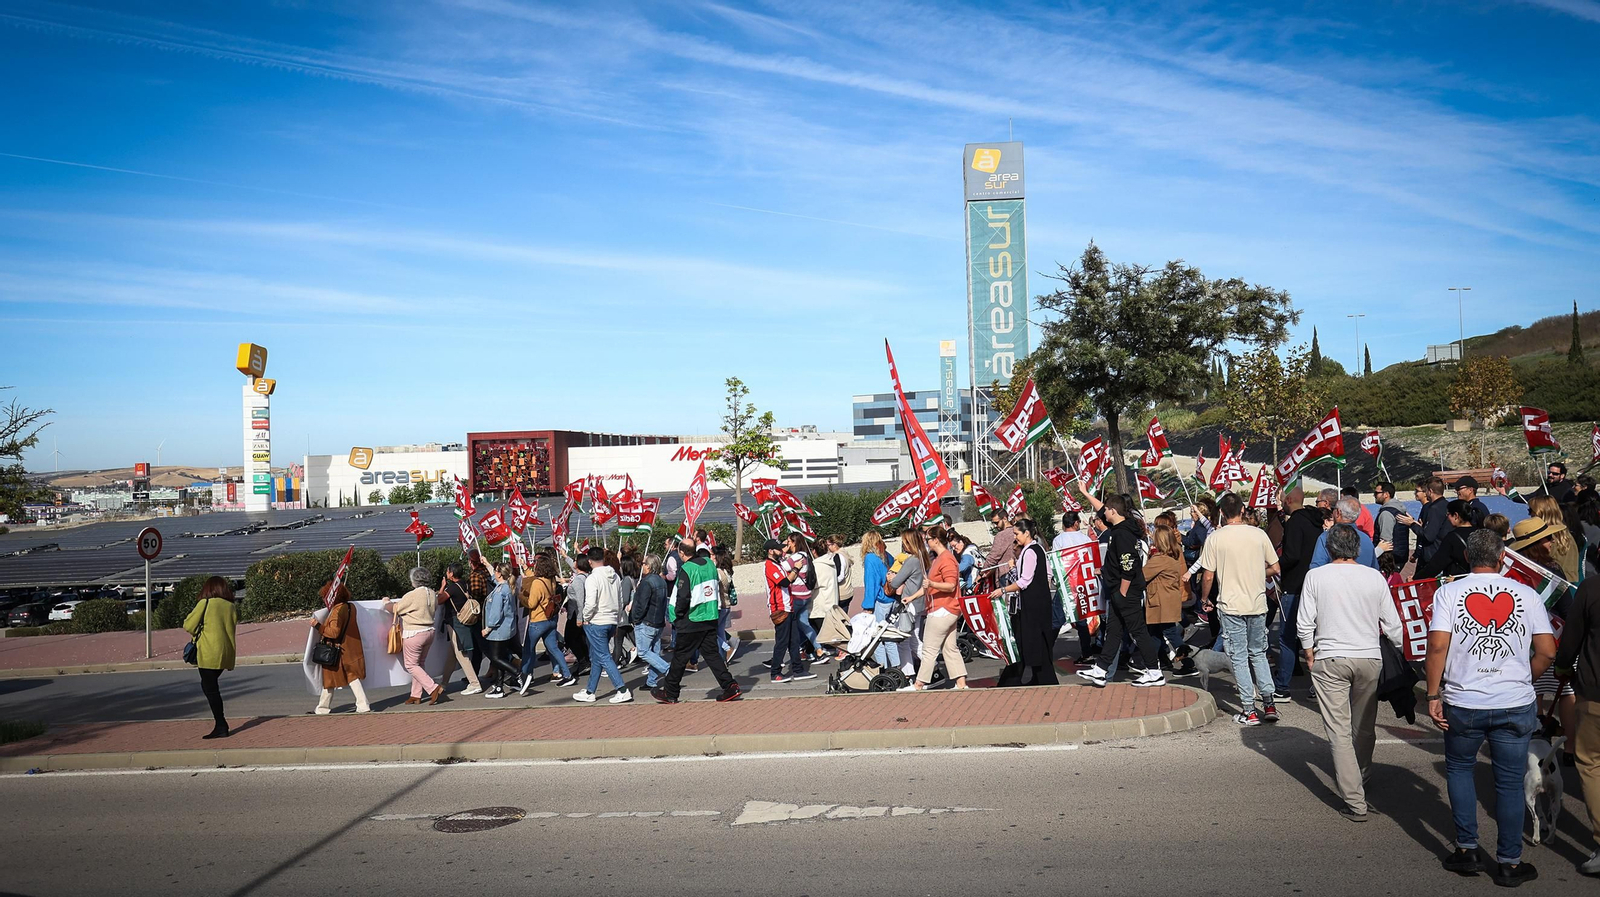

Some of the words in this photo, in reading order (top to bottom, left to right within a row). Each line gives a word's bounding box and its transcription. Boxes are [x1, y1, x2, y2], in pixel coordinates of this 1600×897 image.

[988, 173, 1019, 181] area
[985, 181, 1008, 189] sur
[144, 538, 158, 549] 50
[1078, 547, 1101, 612] CCOO
[1076, 584, 1088, 616] Cádiz
